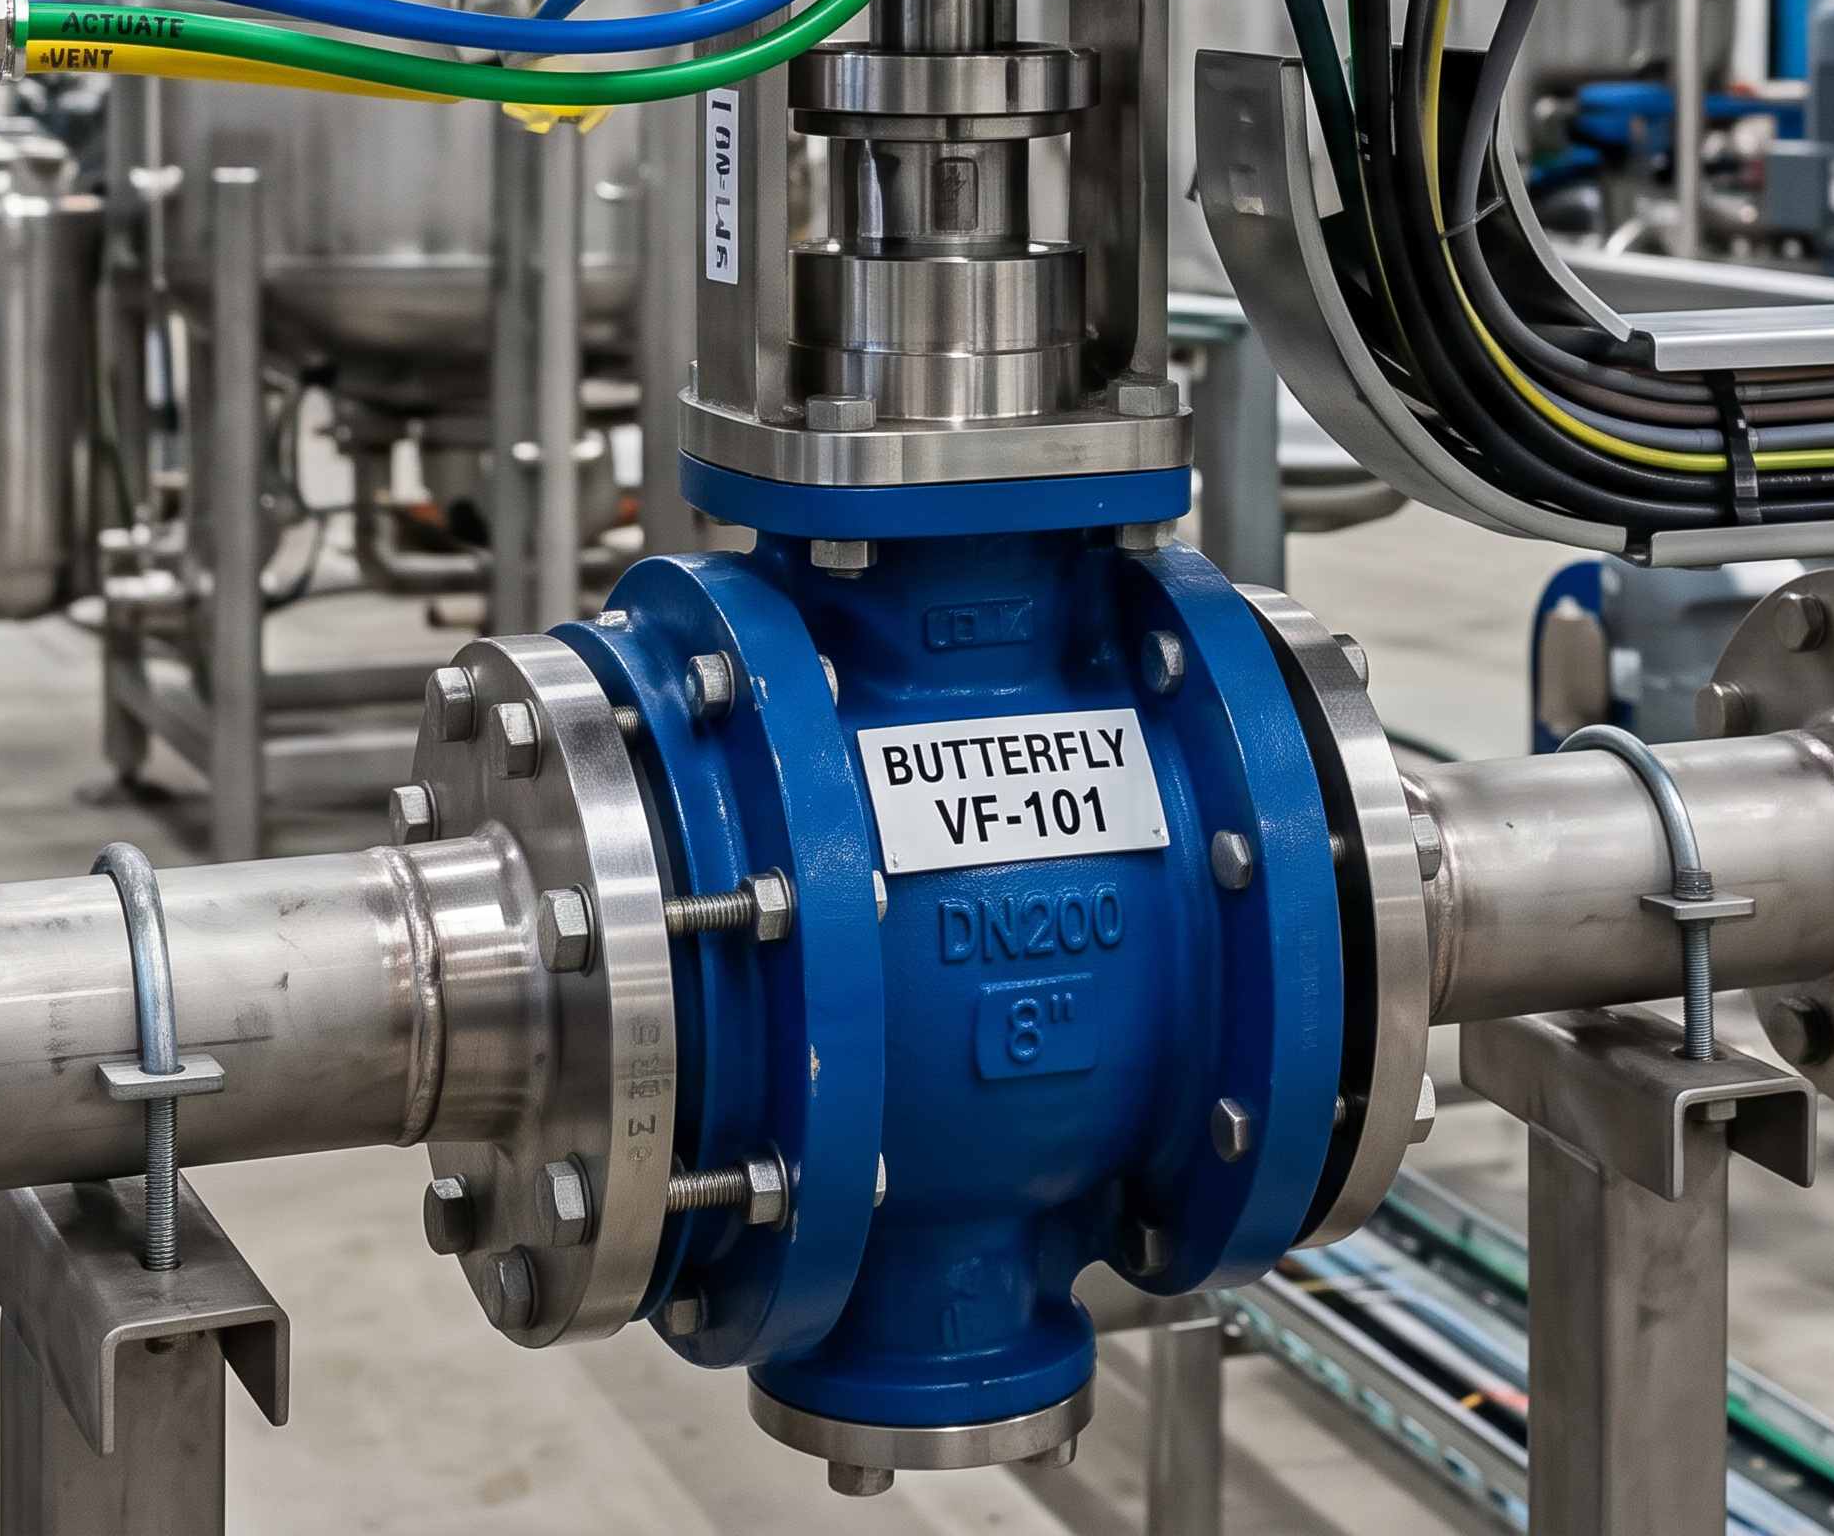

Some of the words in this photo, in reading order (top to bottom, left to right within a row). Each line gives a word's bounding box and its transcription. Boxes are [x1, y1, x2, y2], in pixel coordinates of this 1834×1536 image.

[61, 11, 186, 39] ACTUATE
[881, 728, 1125, 786] BUTTERFLY
[935, 786, 1107, 845] VF-101
[938, 882, 1124, 964] DN200
